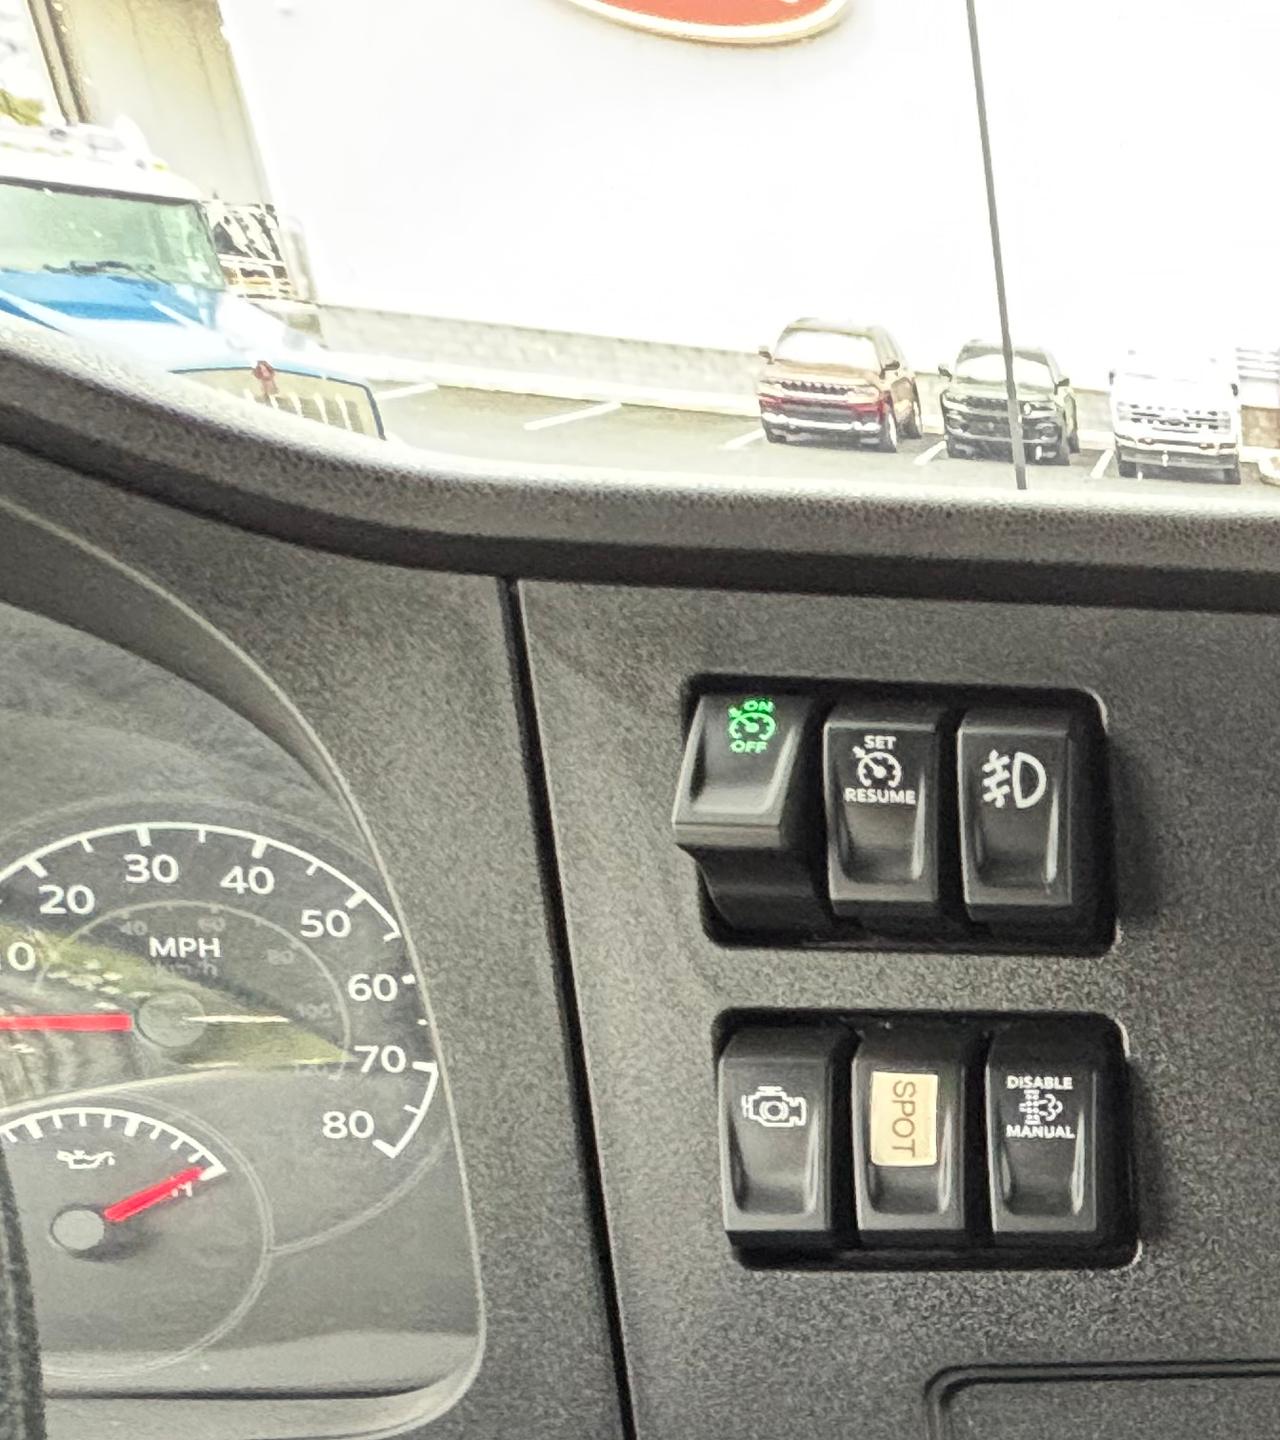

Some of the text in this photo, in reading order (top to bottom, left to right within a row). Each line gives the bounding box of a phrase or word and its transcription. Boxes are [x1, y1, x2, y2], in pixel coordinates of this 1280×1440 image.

[743, 701, 774, 713] ON
[730, 740, 768, 754] OFF
[863, 735, 897, 750] SET
[844, 787, 916, 805] RESUME
[123, 853, 180, 885] 30
[220, 866, 276, 896] 40
[38, 884, 96, 915] 20
[300, 909, 352, 939] 50
[0, 943, 37, 973] 0
[149, 936, 222, 958] MPH
[347, 972, 399, 1002] 60
[353, 1044, 407, 1074] 70
[1006, 1074, 1073, 1091] DISABLE
[322, 1110, 375, 1140] 80
[890, 1079, 917, 1159] SPOT
[1005, 1123, 1076, 1142] MANUAL
